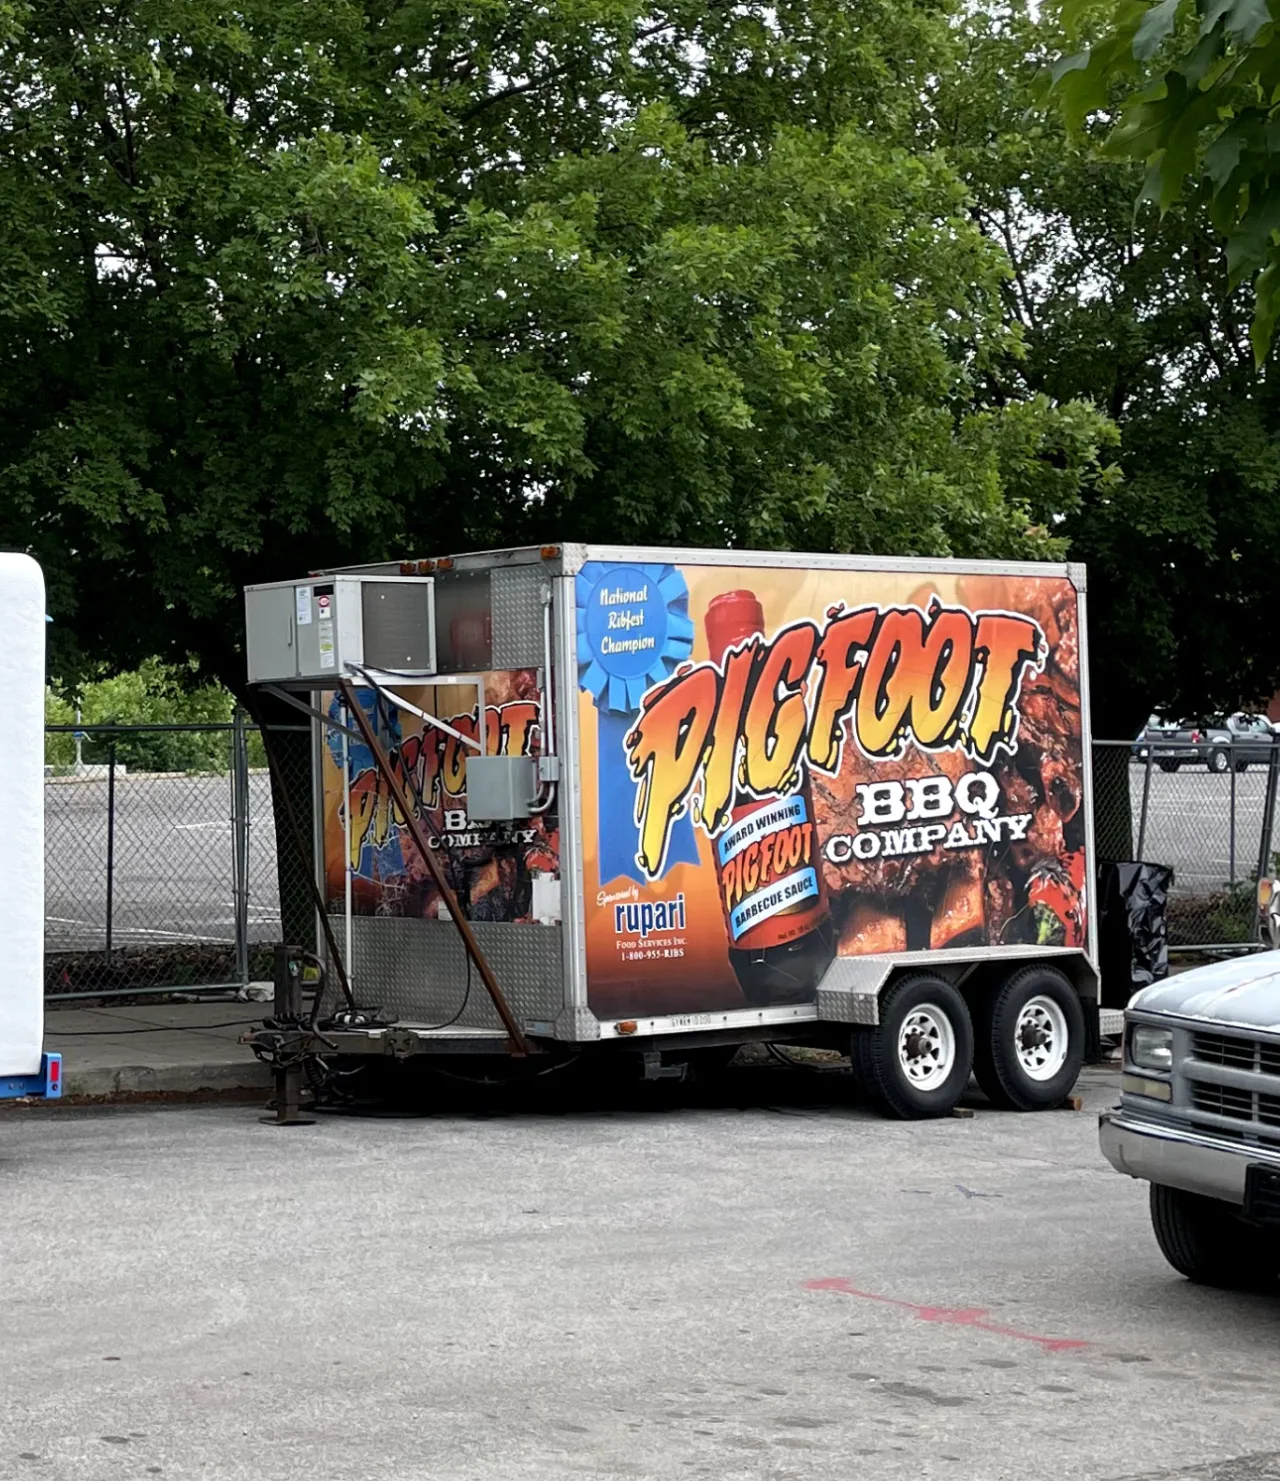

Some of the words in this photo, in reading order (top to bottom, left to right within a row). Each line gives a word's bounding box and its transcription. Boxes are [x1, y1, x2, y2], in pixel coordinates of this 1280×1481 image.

[600, 584, 648, 606] National
[607, 608, 645, 631] Ribfest
[601, 635, 655, 655] Champion
[627, 602, 1044, 878] PIGFOOT
[855, 771, 1001, 826] BBQ
[723, 823, 755, 855] AWARD
[755, 804, 802, 831] WINNING
[824, 813, 1033, 863] COMPANY
[722, 822, 813, 912] PIGFOOT
[614, 892, 686, 938] rupari
[735, 891, 784, 929] BARBECUE
[785, 875, 814, 900] SAUCE
[621, 948, 685, 962] 1-800-955-RIBS
